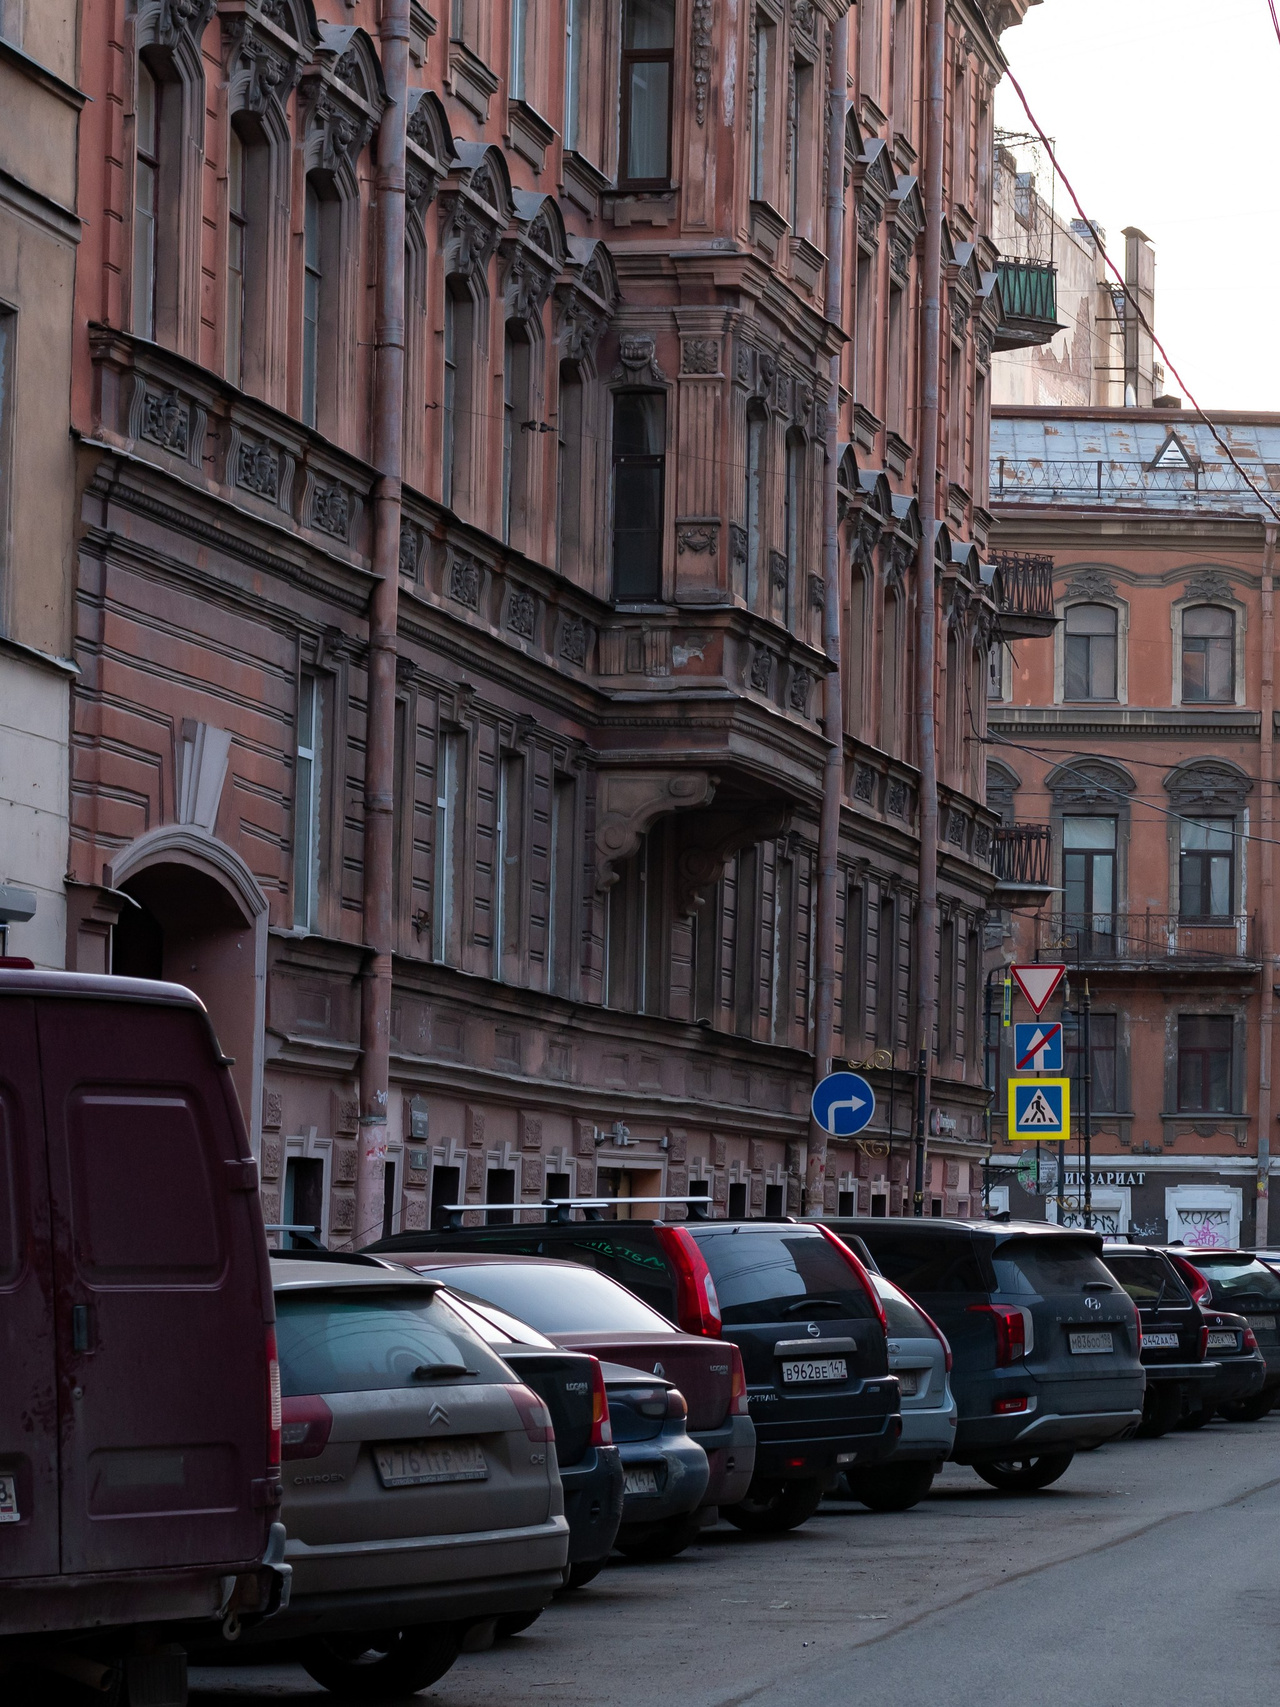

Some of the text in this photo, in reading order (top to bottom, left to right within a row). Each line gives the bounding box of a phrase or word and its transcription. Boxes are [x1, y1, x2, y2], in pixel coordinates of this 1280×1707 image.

[786, 1361, 843, 1380] В962ВЕ 147
[565, 1381, 588, 1392] LOGAN
[747, 1394, 779, 1403] X-TRAIL
[530, 1453, 546, 1465] C5
